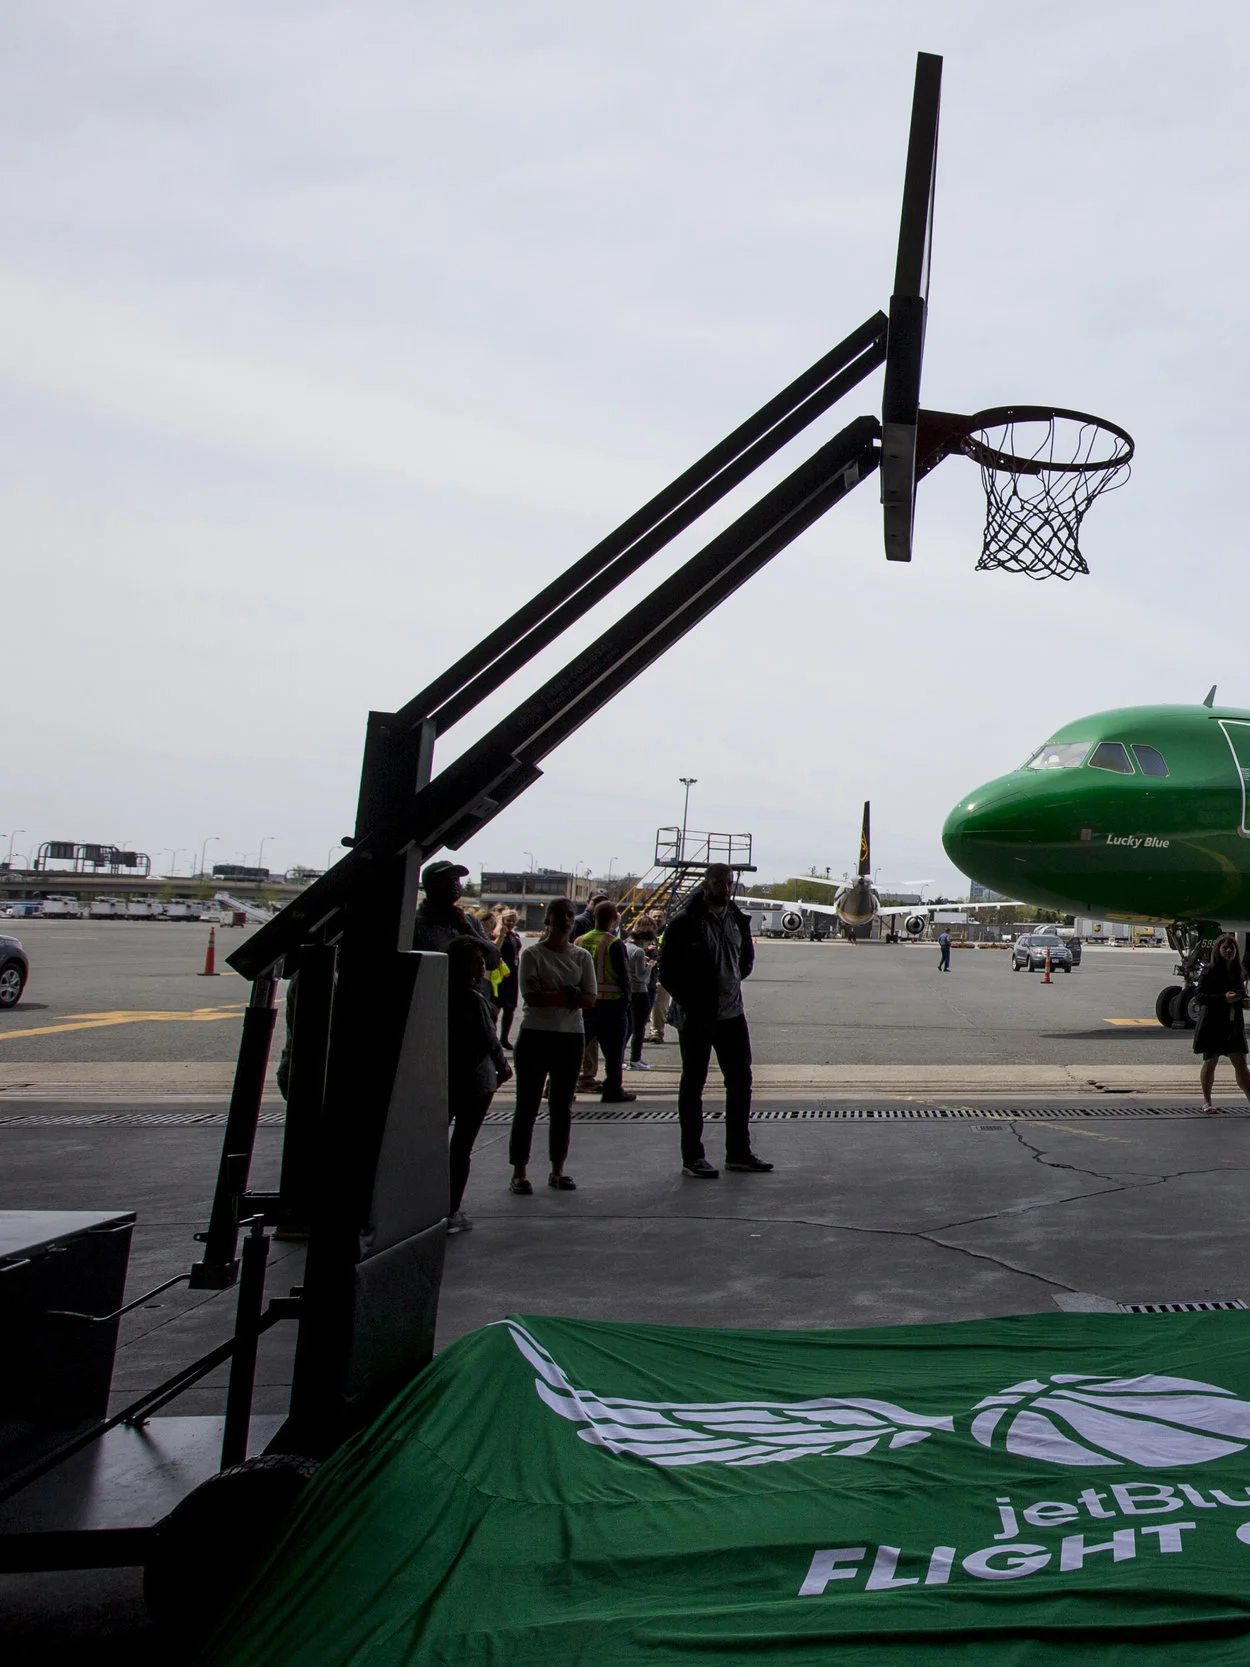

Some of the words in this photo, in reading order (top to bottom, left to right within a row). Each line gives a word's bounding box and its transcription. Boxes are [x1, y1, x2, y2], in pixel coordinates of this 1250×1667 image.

[1106, 834, 1143, 849] Lucky
[1144, 837, 1170, 848] Blue
[798, 1521, 1197, 1597] FLIGHT
